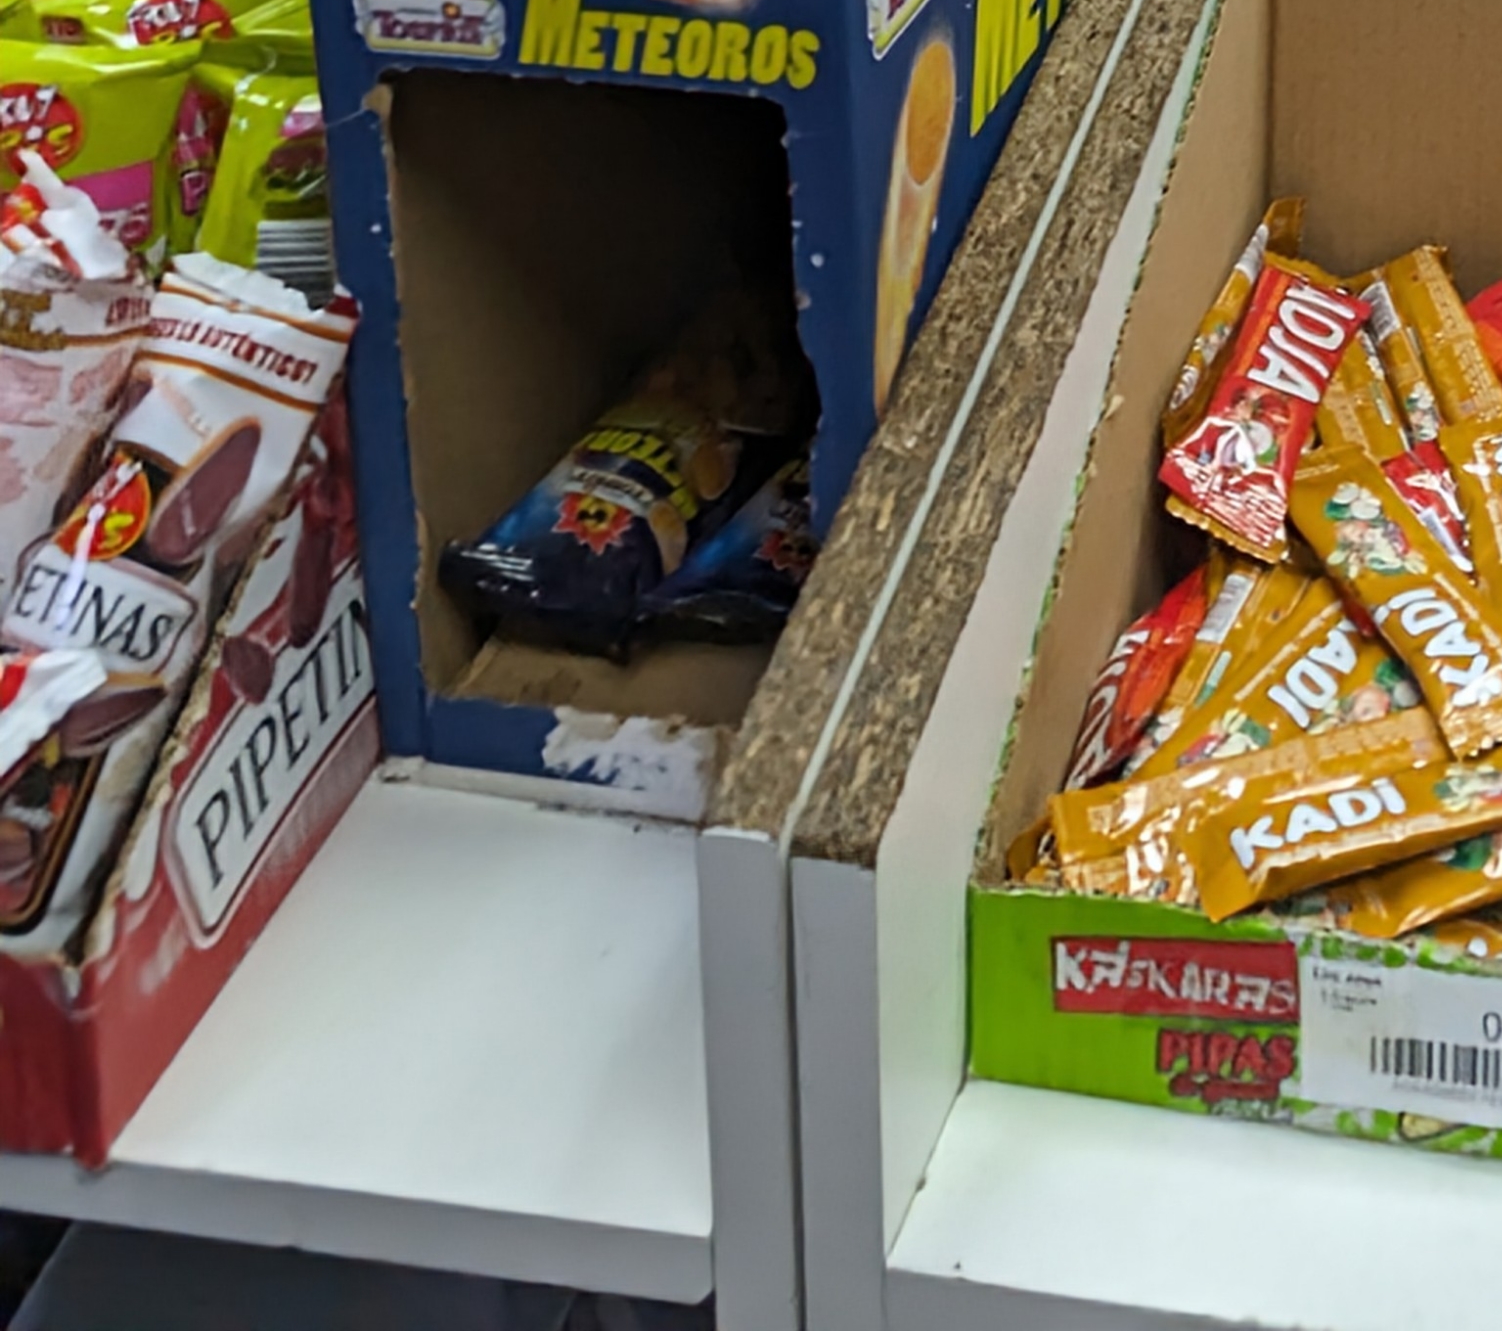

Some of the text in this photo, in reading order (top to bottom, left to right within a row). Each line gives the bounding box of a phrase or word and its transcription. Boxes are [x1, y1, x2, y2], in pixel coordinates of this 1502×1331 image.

[13, 562, 174, 663] ETINAS
[1267, 615, 1363, 730] ADI
[196, 594, 370, 890] PIPETIN
[1229, 777, 1407, 870] KADI
[1157, 1027, 1298, 1083] PIPAS
